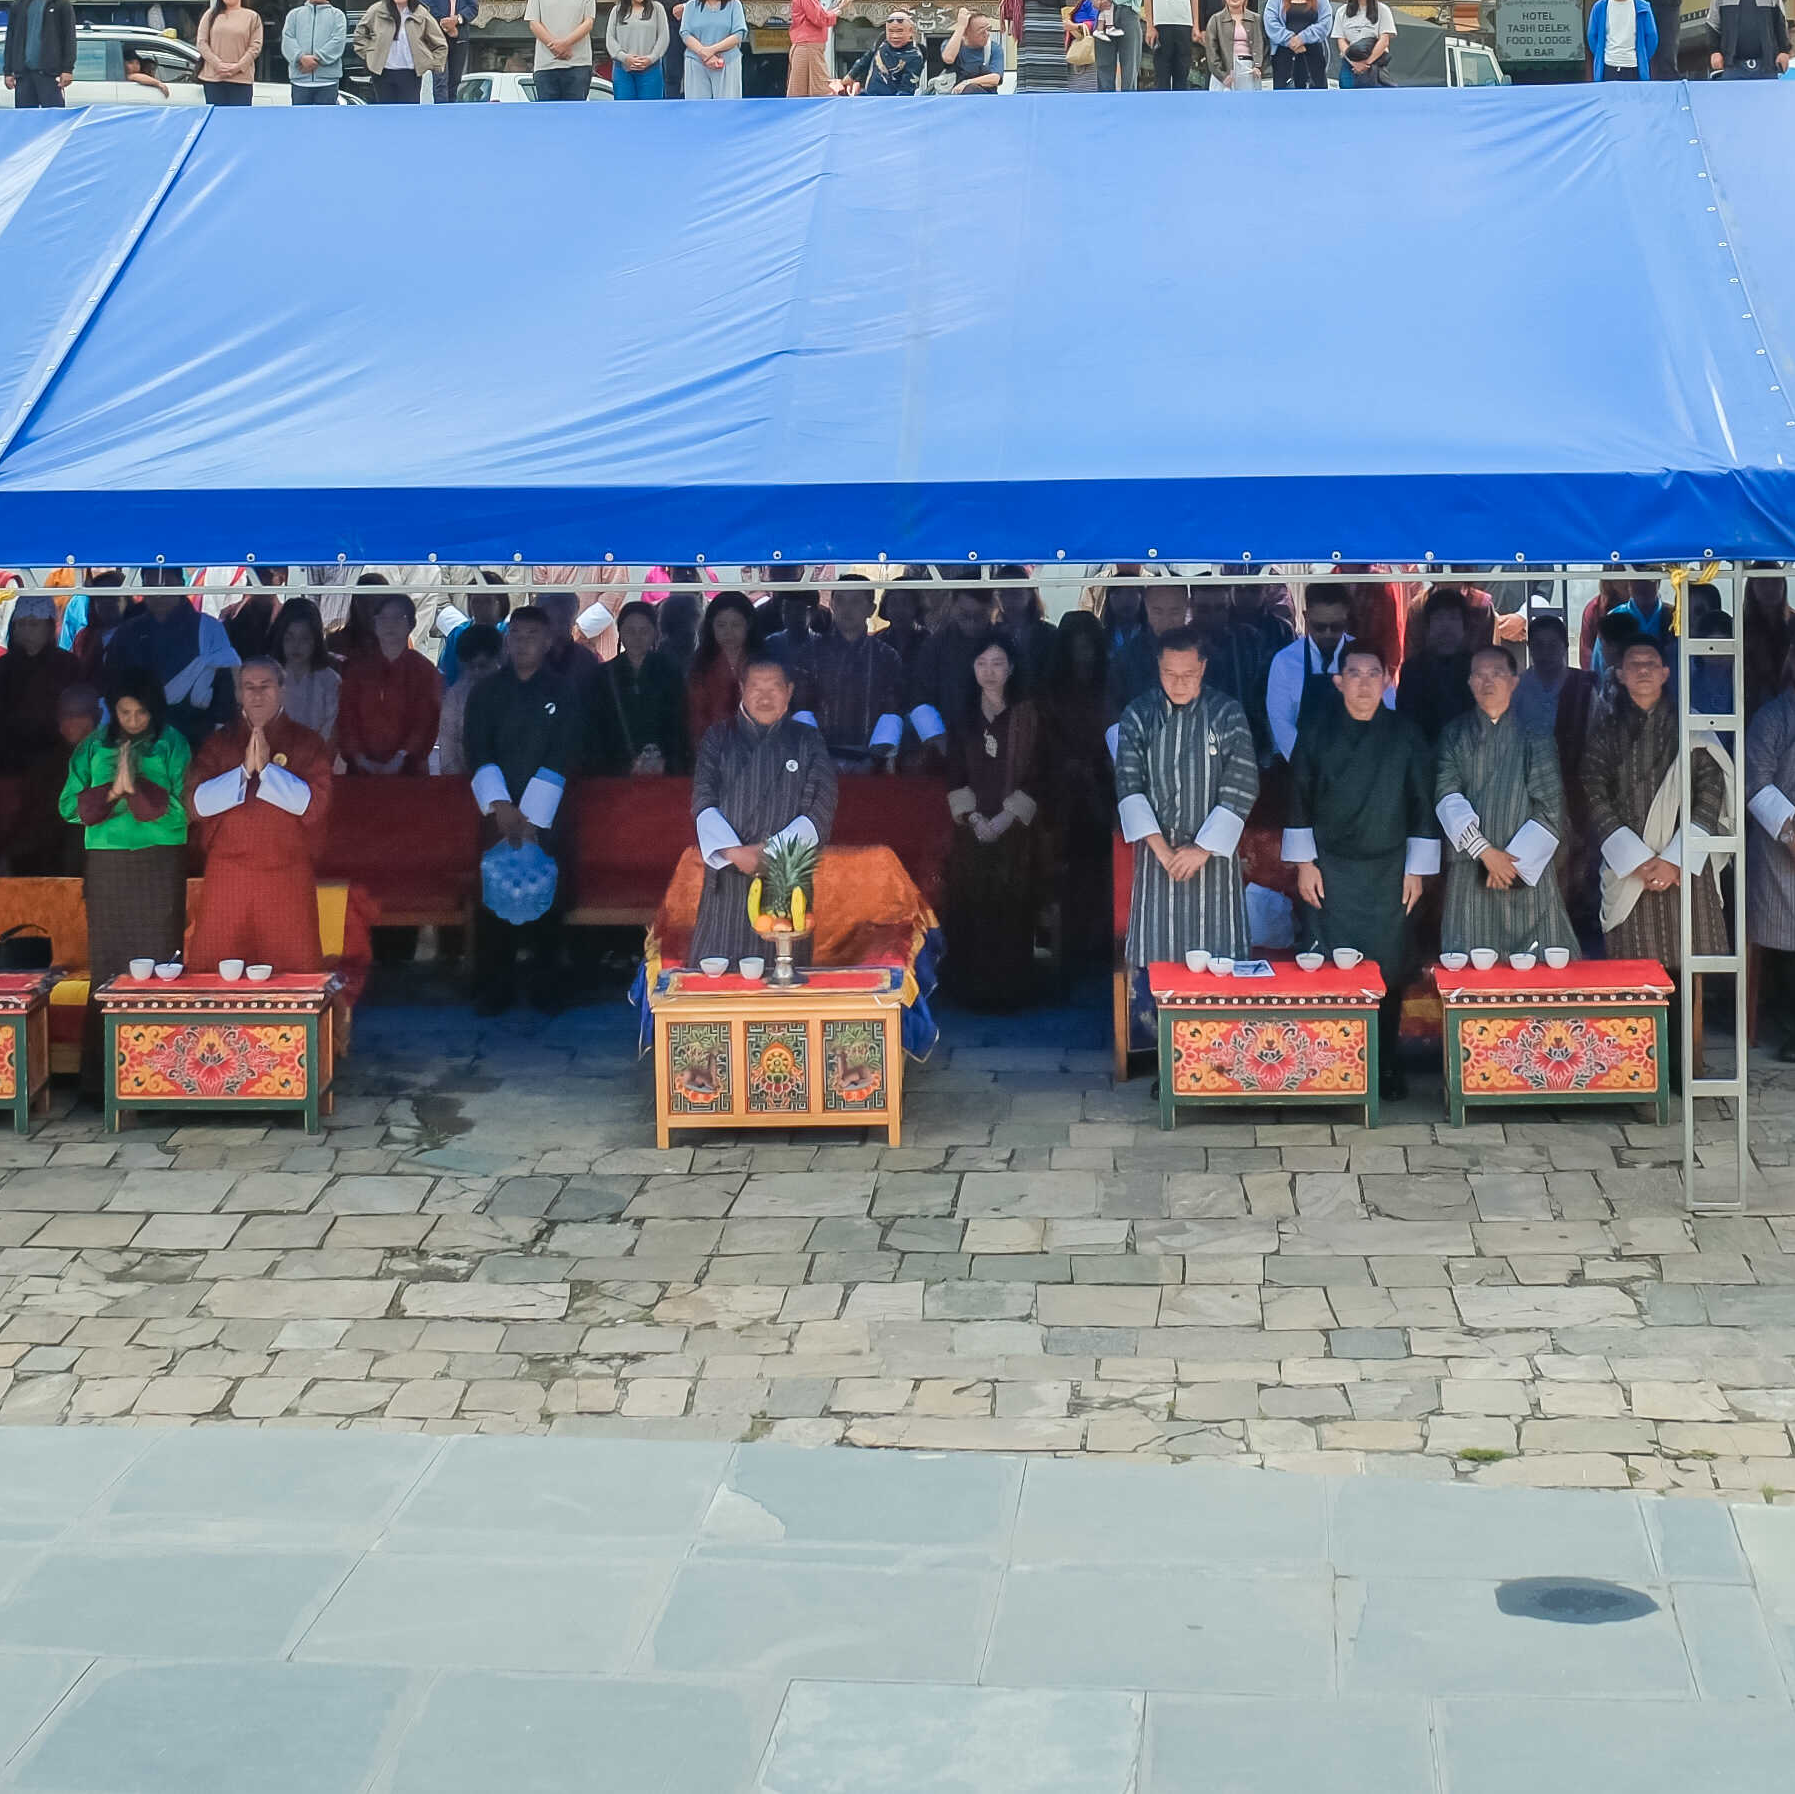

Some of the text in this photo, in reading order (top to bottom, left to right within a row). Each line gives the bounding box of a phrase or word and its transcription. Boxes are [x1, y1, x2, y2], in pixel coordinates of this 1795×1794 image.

[1522, 12, 1555, 21] HOTEL
[1508, 24, 1571, 33] TASHI DELEK
[1538, 36, 1573, 45] LODGE
[1534, 49, 1555, 57] BAR
